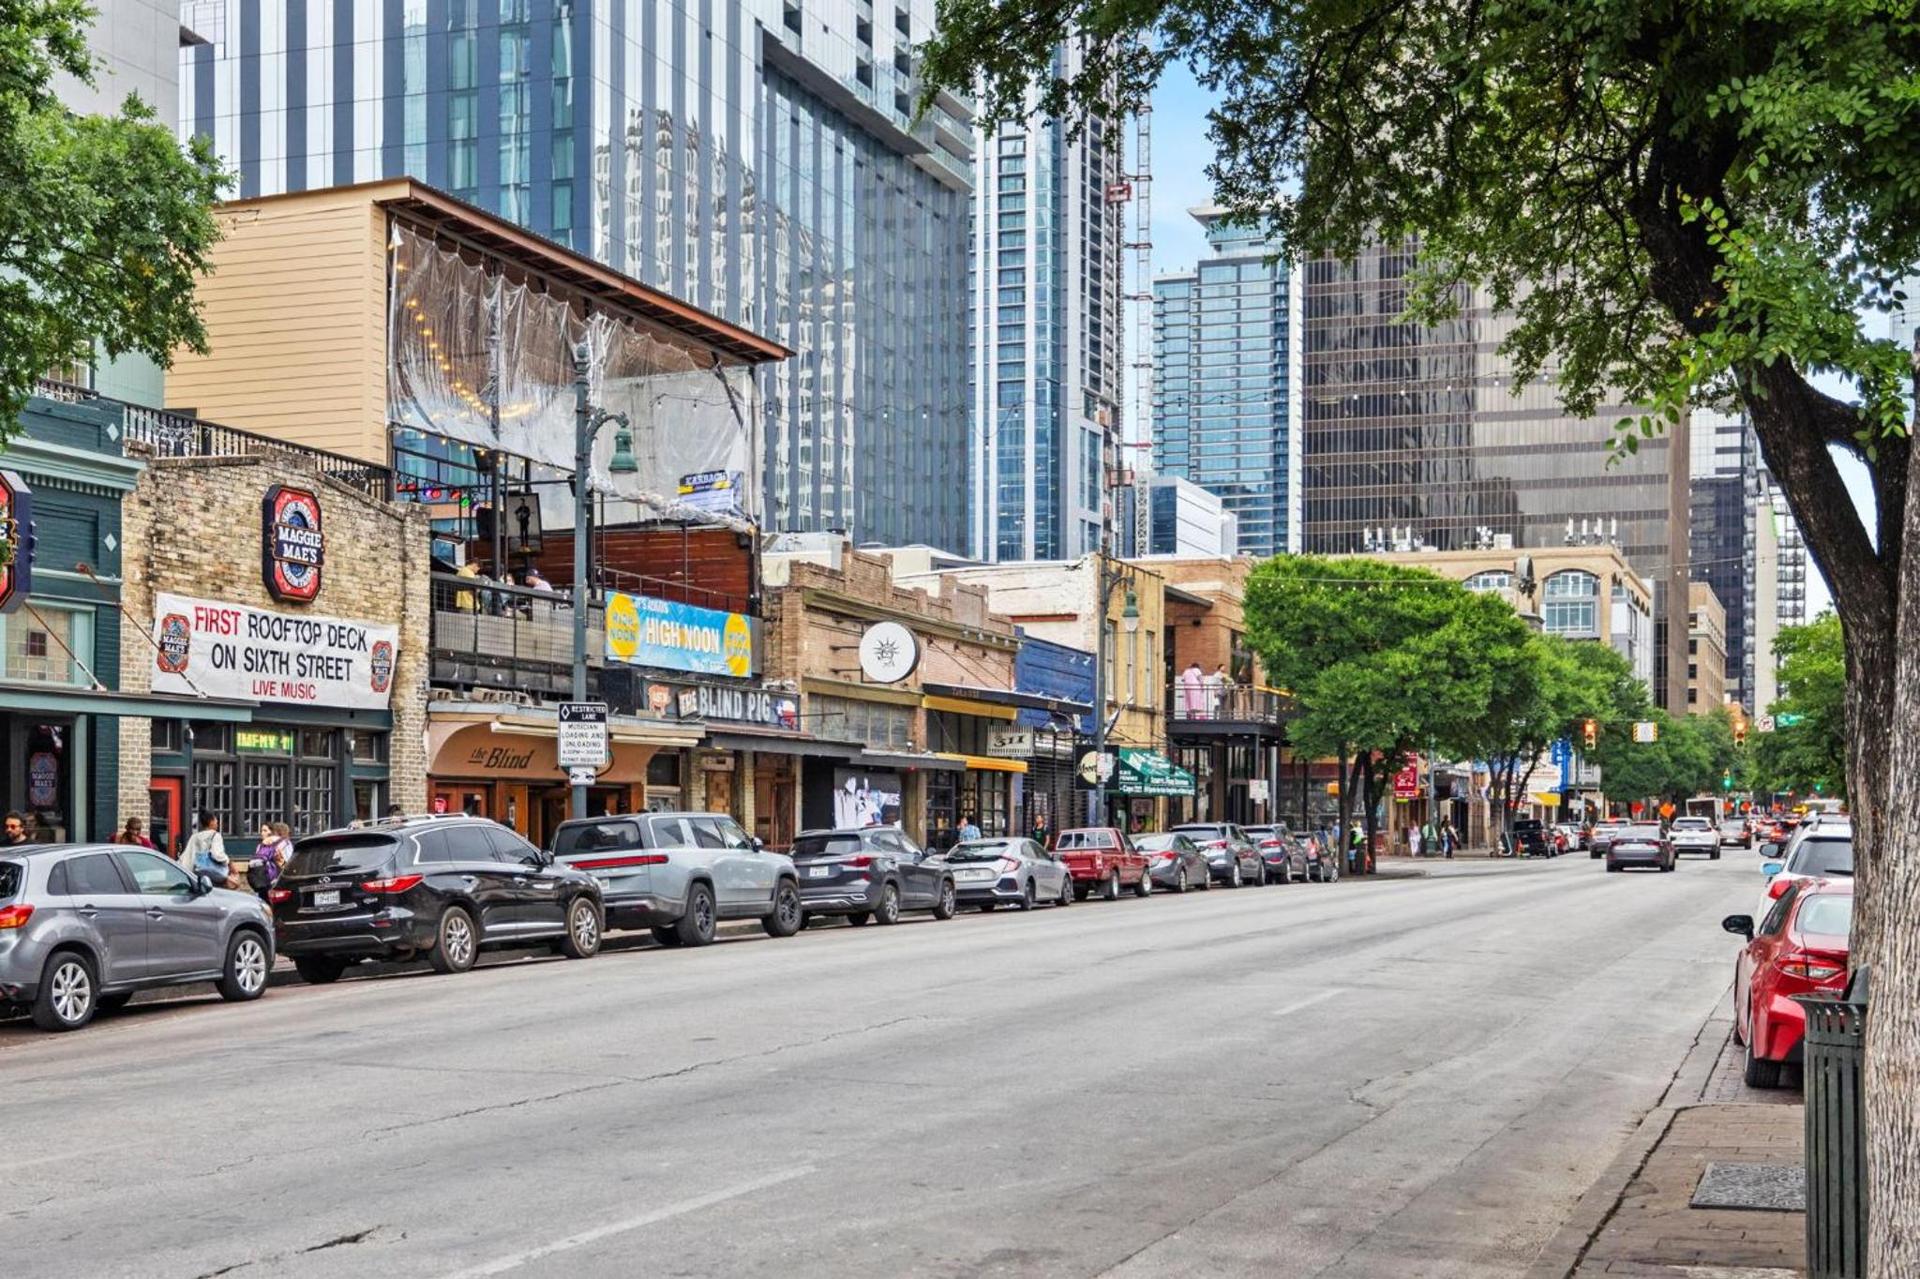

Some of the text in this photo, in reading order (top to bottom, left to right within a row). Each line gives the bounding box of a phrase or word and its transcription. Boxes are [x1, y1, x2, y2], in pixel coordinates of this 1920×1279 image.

[278, 526, 322, 548] MAGGIE
[283, 543, 317, 563] MAE'S
[194, 606, 368, 652] FIRST ROOFTOP DECK
[645, 617, 680, 649] HIGH
[684, 624, 720, 654] NOON
[211, 643, 353, 682] ON SIXTH STREET
[252, 679, 316, 700] LIVE MUSIC
[700, 686, 743, 720] BLIND
[747, 692, 771, 722] PIG
[484, 747, 535, 769] Blind
